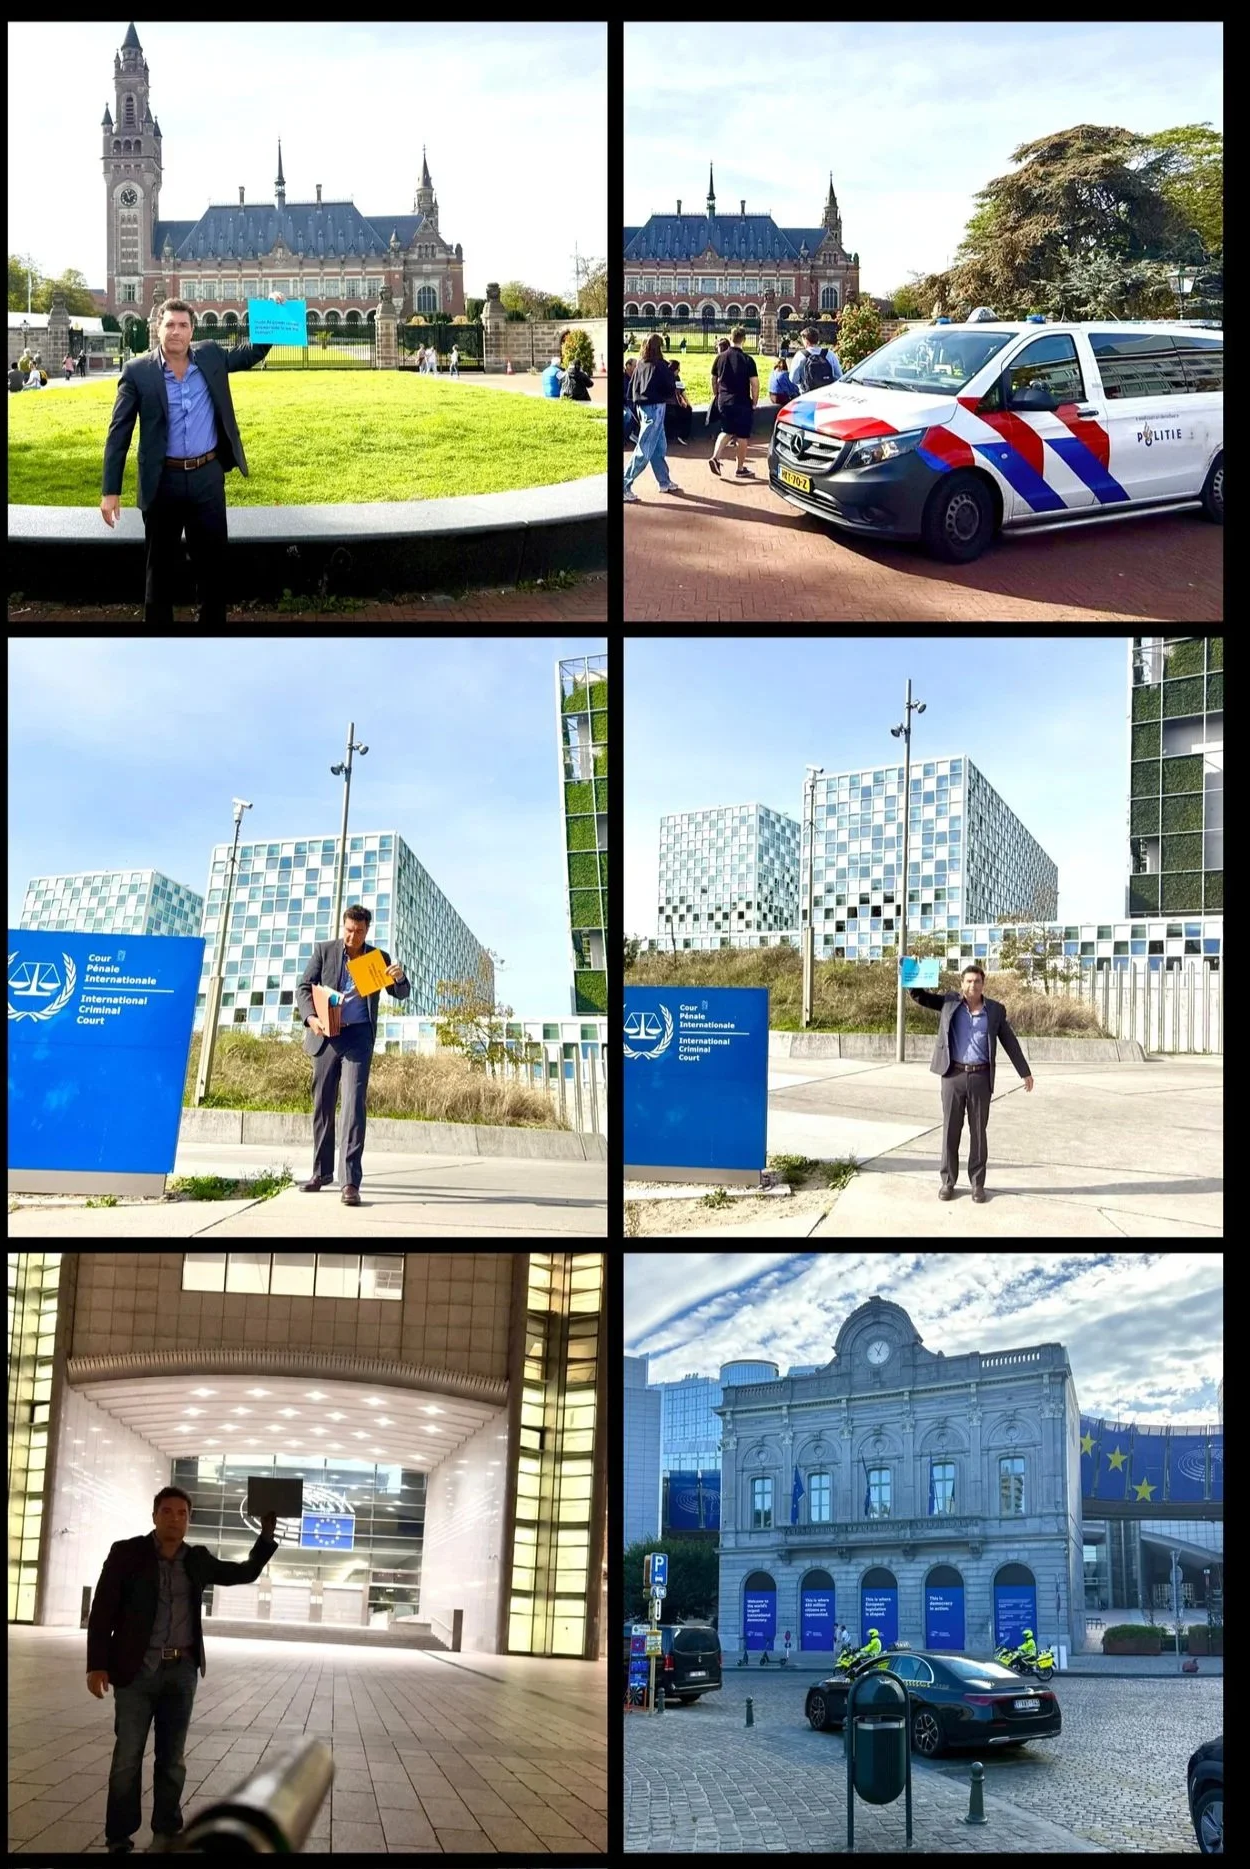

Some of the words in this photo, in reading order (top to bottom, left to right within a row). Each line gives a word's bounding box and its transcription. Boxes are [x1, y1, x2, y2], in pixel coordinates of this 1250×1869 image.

[1137, 428, 1182, 447] POLITIE
[88, 954, 111, 962] Cour
[86, 964, 120, 973] Pénale
[84, 974, 157, 985] Internationale
[80, 994, 148, 1005] International
[78, 1005, 121, 1015] Criminal
[679, 1004, 698, 1012] Cour
[76, 1016, 105, 1025] Court
[679, 1012, 705, 1020] Pénale
[679, 1021, 735, 1029] Internationale
[679, 1037, 730, 1045] International
[678, 1045, 711, 1053] Criminal
[655, 1556, 664, 1572] P
